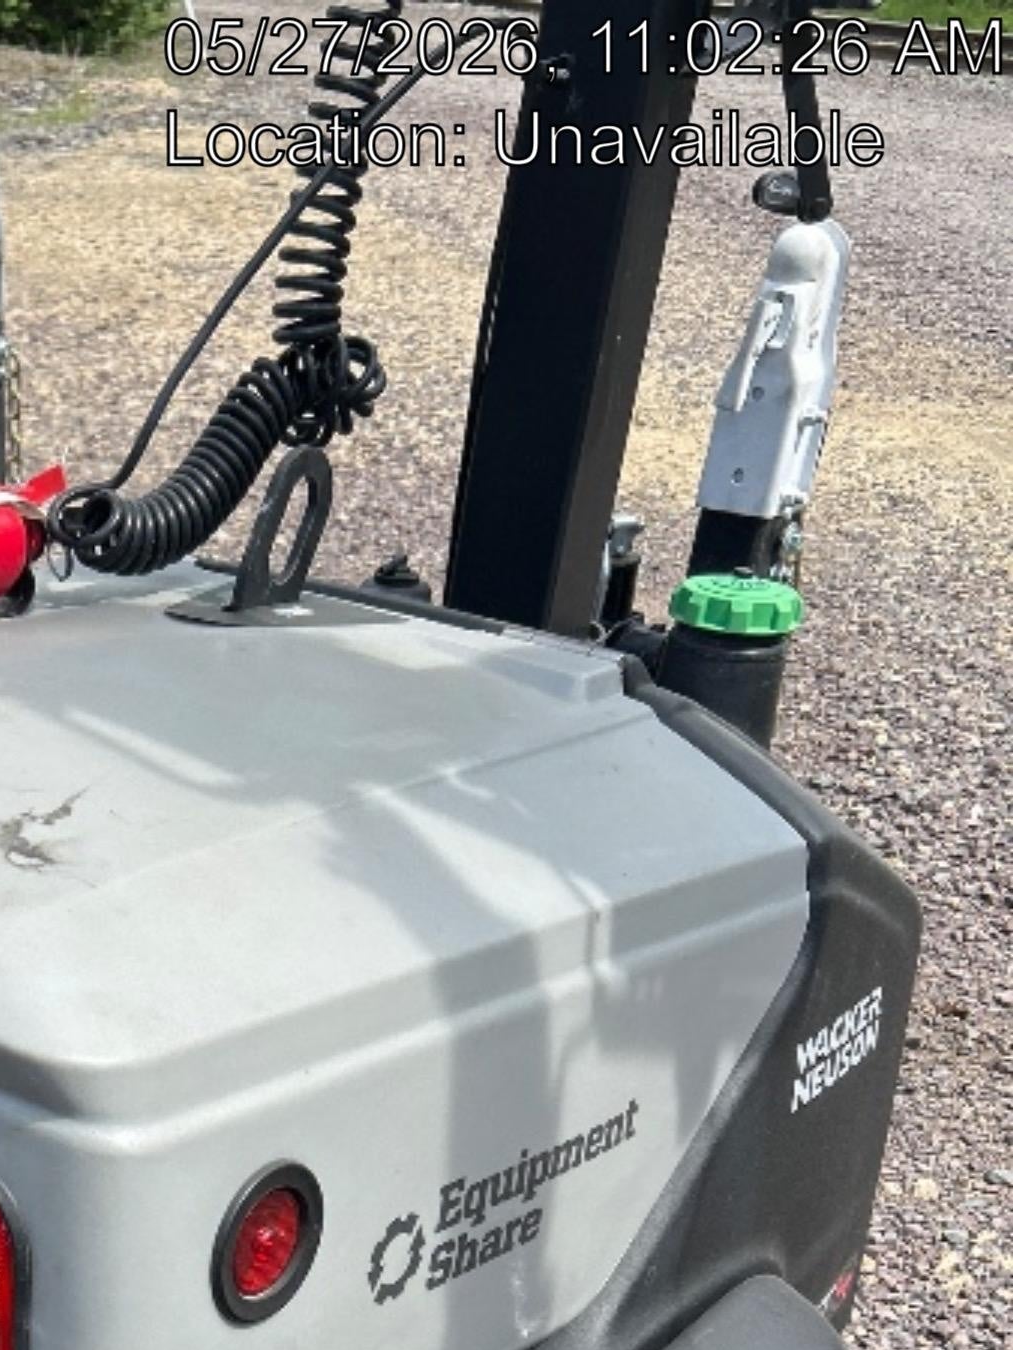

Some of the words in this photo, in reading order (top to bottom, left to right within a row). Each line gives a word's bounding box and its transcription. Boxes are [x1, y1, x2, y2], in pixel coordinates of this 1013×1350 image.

[790, 1020, 881, 1114] NEUSON
[796, 986, 884, 1075] WACKER
[434, 1098, 639, 1233] Equipment
[425, 1207, 543, 1291] Share
